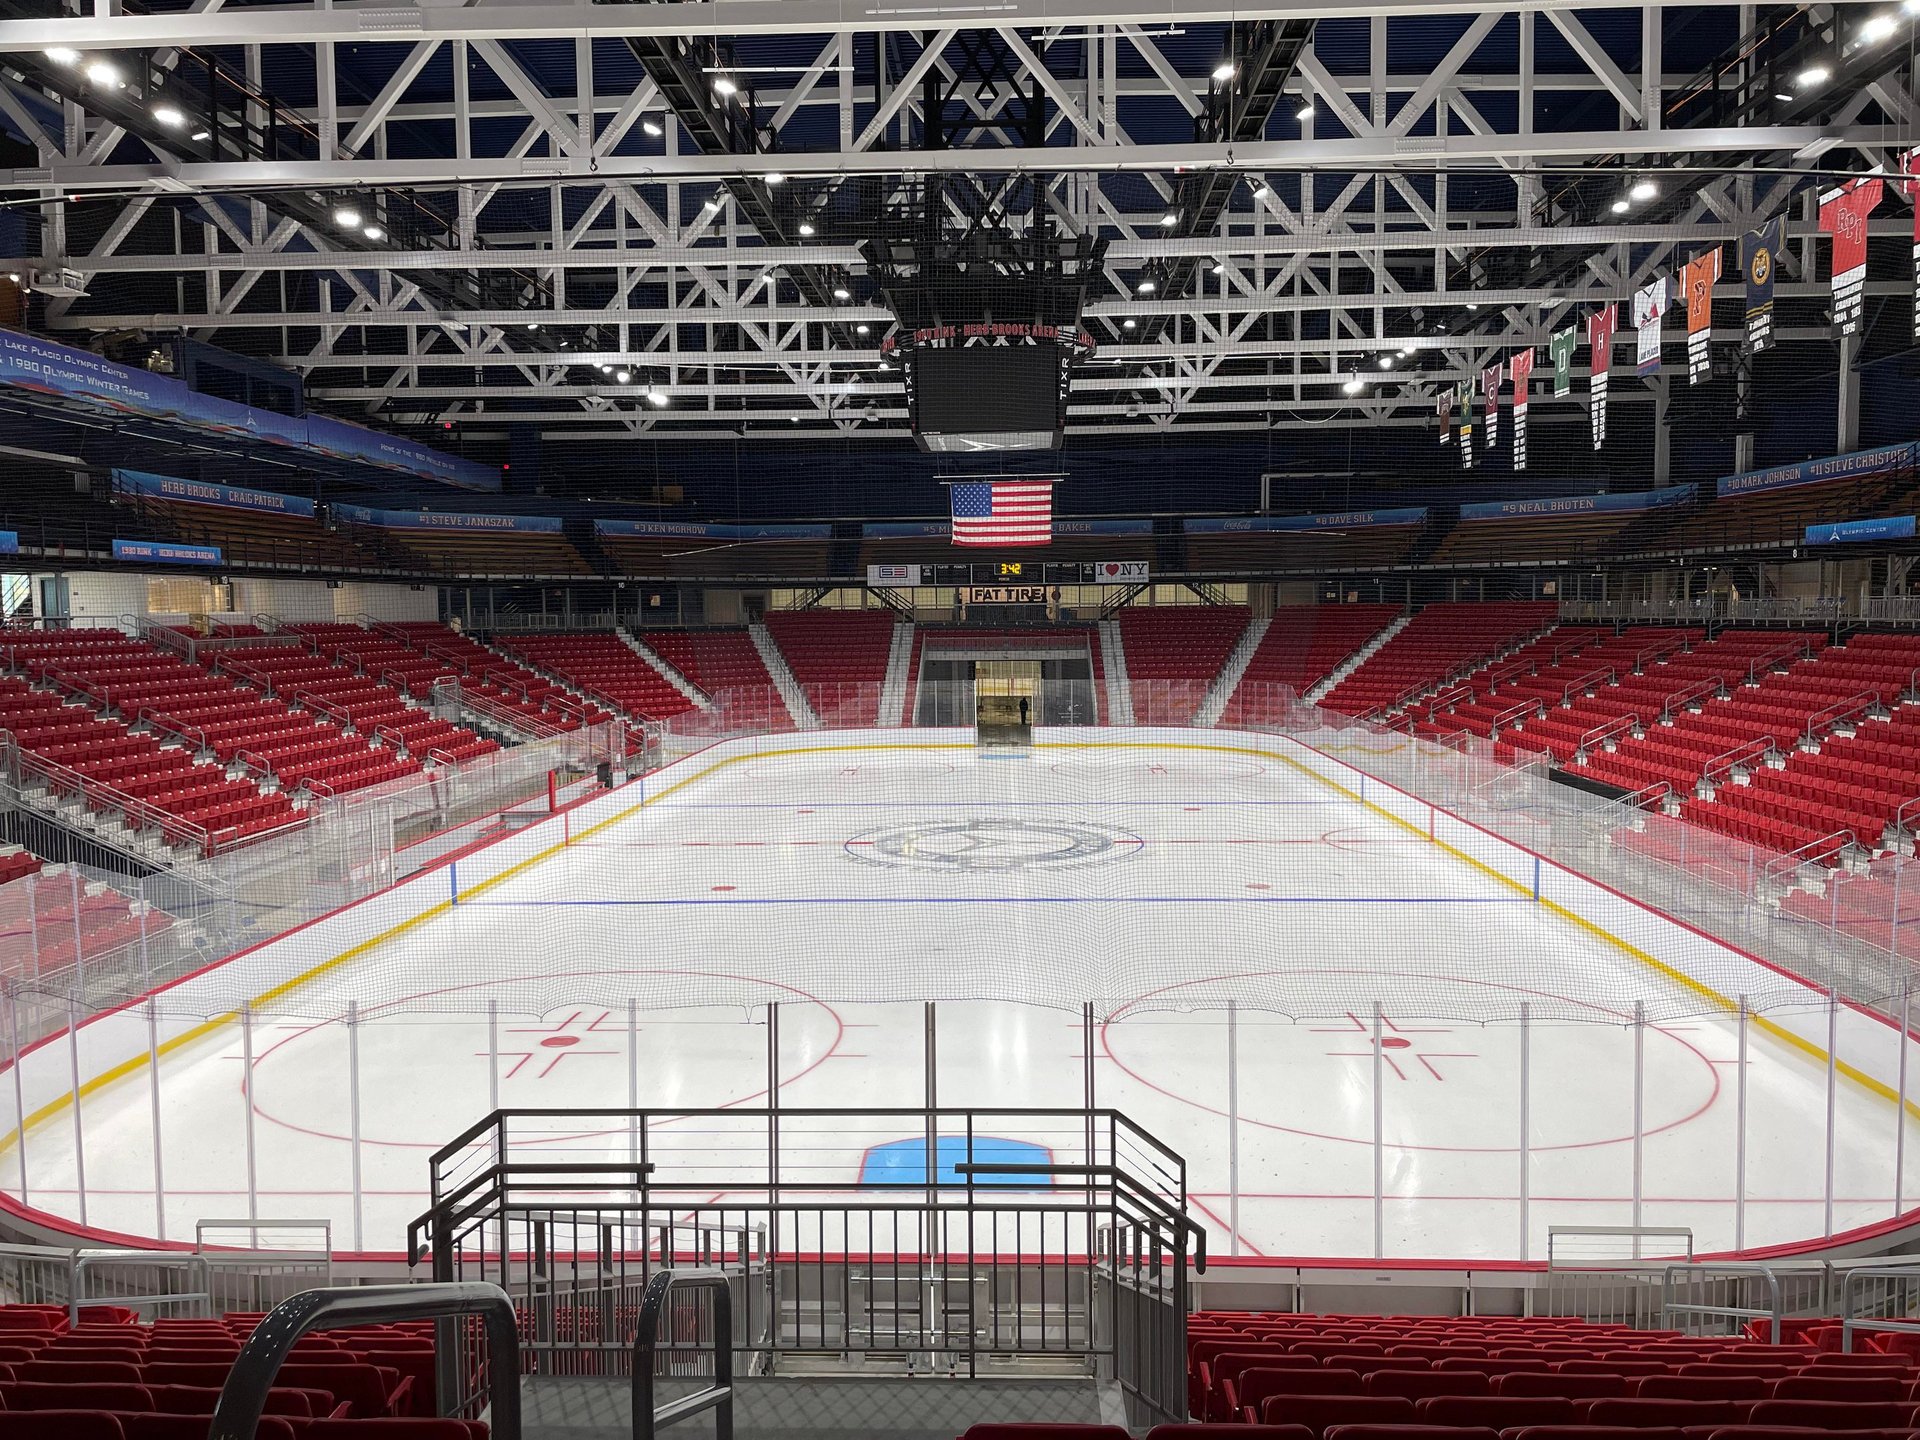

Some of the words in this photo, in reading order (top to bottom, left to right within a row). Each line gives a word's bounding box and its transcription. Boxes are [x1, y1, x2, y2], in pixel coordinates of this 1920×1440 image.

[1838, 208, 1861, 244] RPI
[1693, 279, 1706, 316] P
[963, 324, 989, 336] HERB
[991, 324, 1030, 335] BROOKS
[1032, 325, 1059, 337] ARENA
[1598, 332, 1604, 350] H
[5, 339, 28, 352] LAKE
[31, 346, 62, 360] PLACID
[64, 355, 98, 370] OLYMPIC
[101, 364, 129, 379] CENTER
[1558, 348, 1566, 373] D
[8, 356, 39, 372] 1980
[43, 364, 84, 383] OLYMPIC
[86, 375, 120, 391] WINTER
[121, 385, 150, 400] GAMES
[904, 362, 914, 405] TIXR
[1060, 358, 1069, 400] TIXR
[1488, 387, 1495, 400] C
[1810, 464, 1823, 475] #11
[1824, 457, 1853, 473] STEVE
[1727, 479, 1740, 490] #10
[1741, 474, 1763, 488] MARK
[1764, 467, 1801, 484] JOHNSON
[161, 480, 185, 494] HERB
[187, 484, 220, 499] BROOKS
[228, 490, 253, 504] CRAIG
[254, 494, 285, 508] PATRICK
[1502, 504, 1517, 513] #9
[1519, 502, 1547, 513] NEAL
[1550, 499, 1594, 511] BROTEN
[419, 515, 430, 524] #1
[431, 515, 463, 525] STEVE
[464, 517, 515, 528] JANASZAK
[1058, 523, 1092, 532] BAKER
[1329, 516, 1351, 525] DAVE
[1353, 513, 1374, 523] SILK
[634, 523, 646, 532] #3
[647, 524, 666, 533] KEN
[668, 524, 706, 534] MORROW
[1001, 563, 1021, 574] 3:42
[1097, 564, 1105, 576] I
[1120, 563, 1148, 575] NY
[974, 589, 1001, 600] FAT
[1005, 588, 1042, 600] TIRE
